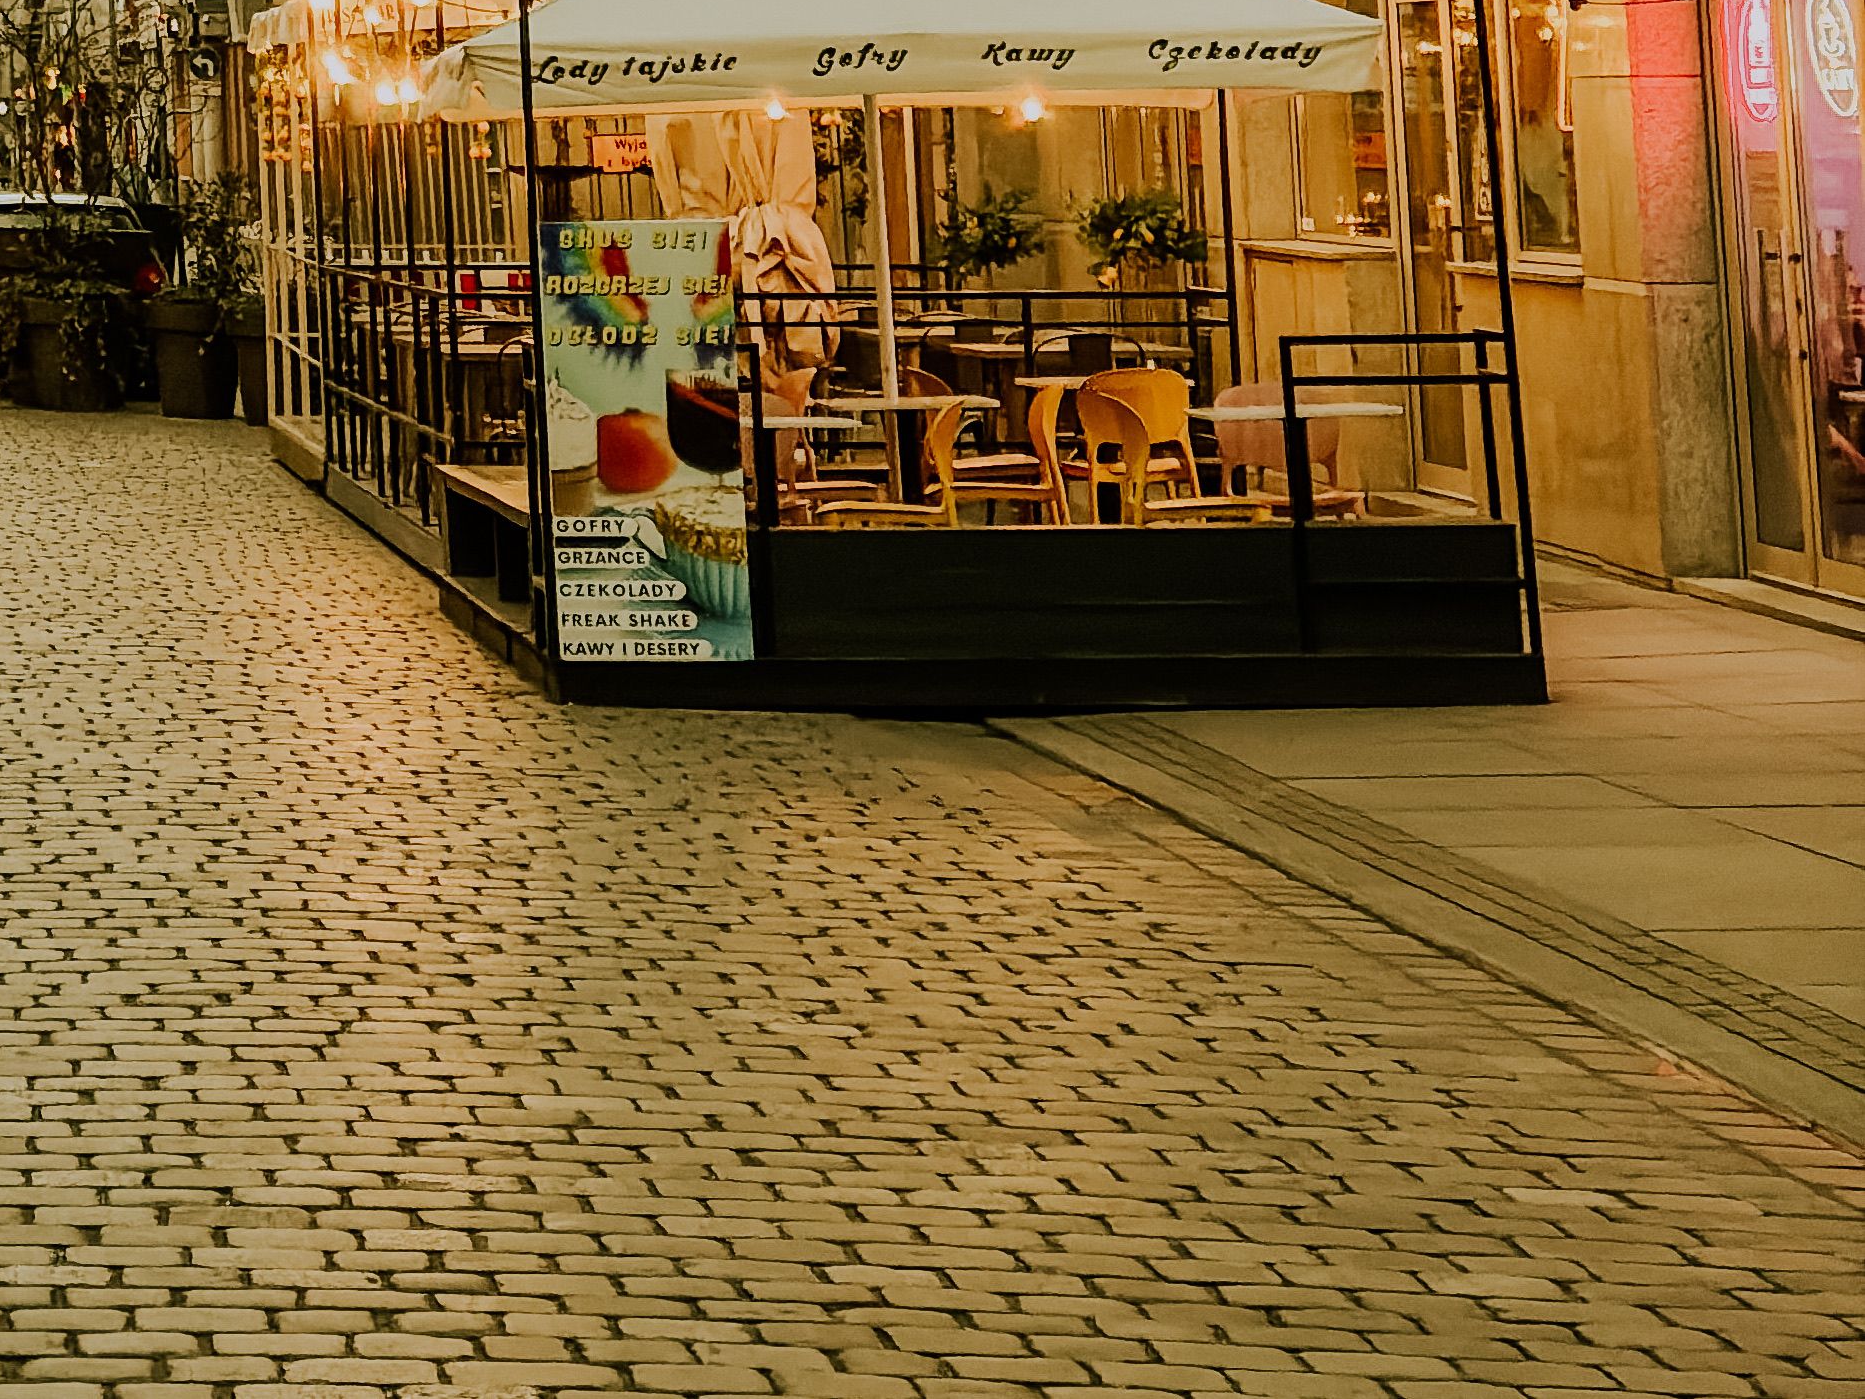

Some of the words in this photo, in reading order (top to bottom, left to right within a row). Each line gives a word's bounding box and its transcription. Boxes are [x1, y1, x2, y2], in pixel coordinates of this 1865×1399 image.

[533, 55, 609, 86] Lody
[622, 52, 738, 83] tajskie
[812, 42, 909, 77] Gofry
[981, 40, 1077, 71] Kawy
[1147, 38, 1323, 73] Czekolady
[555, 519, 625, 533] GOFRY
[559, 583, 677, 597] CZEKOLADY
[561, 613, 621, 627] FREAK
[628, 613, 692, 627] SHAKE
[563, 642, 615, 656] KAWY
[622, 642, 628, 656] I
[634, 642, 701, 656] DESERY
